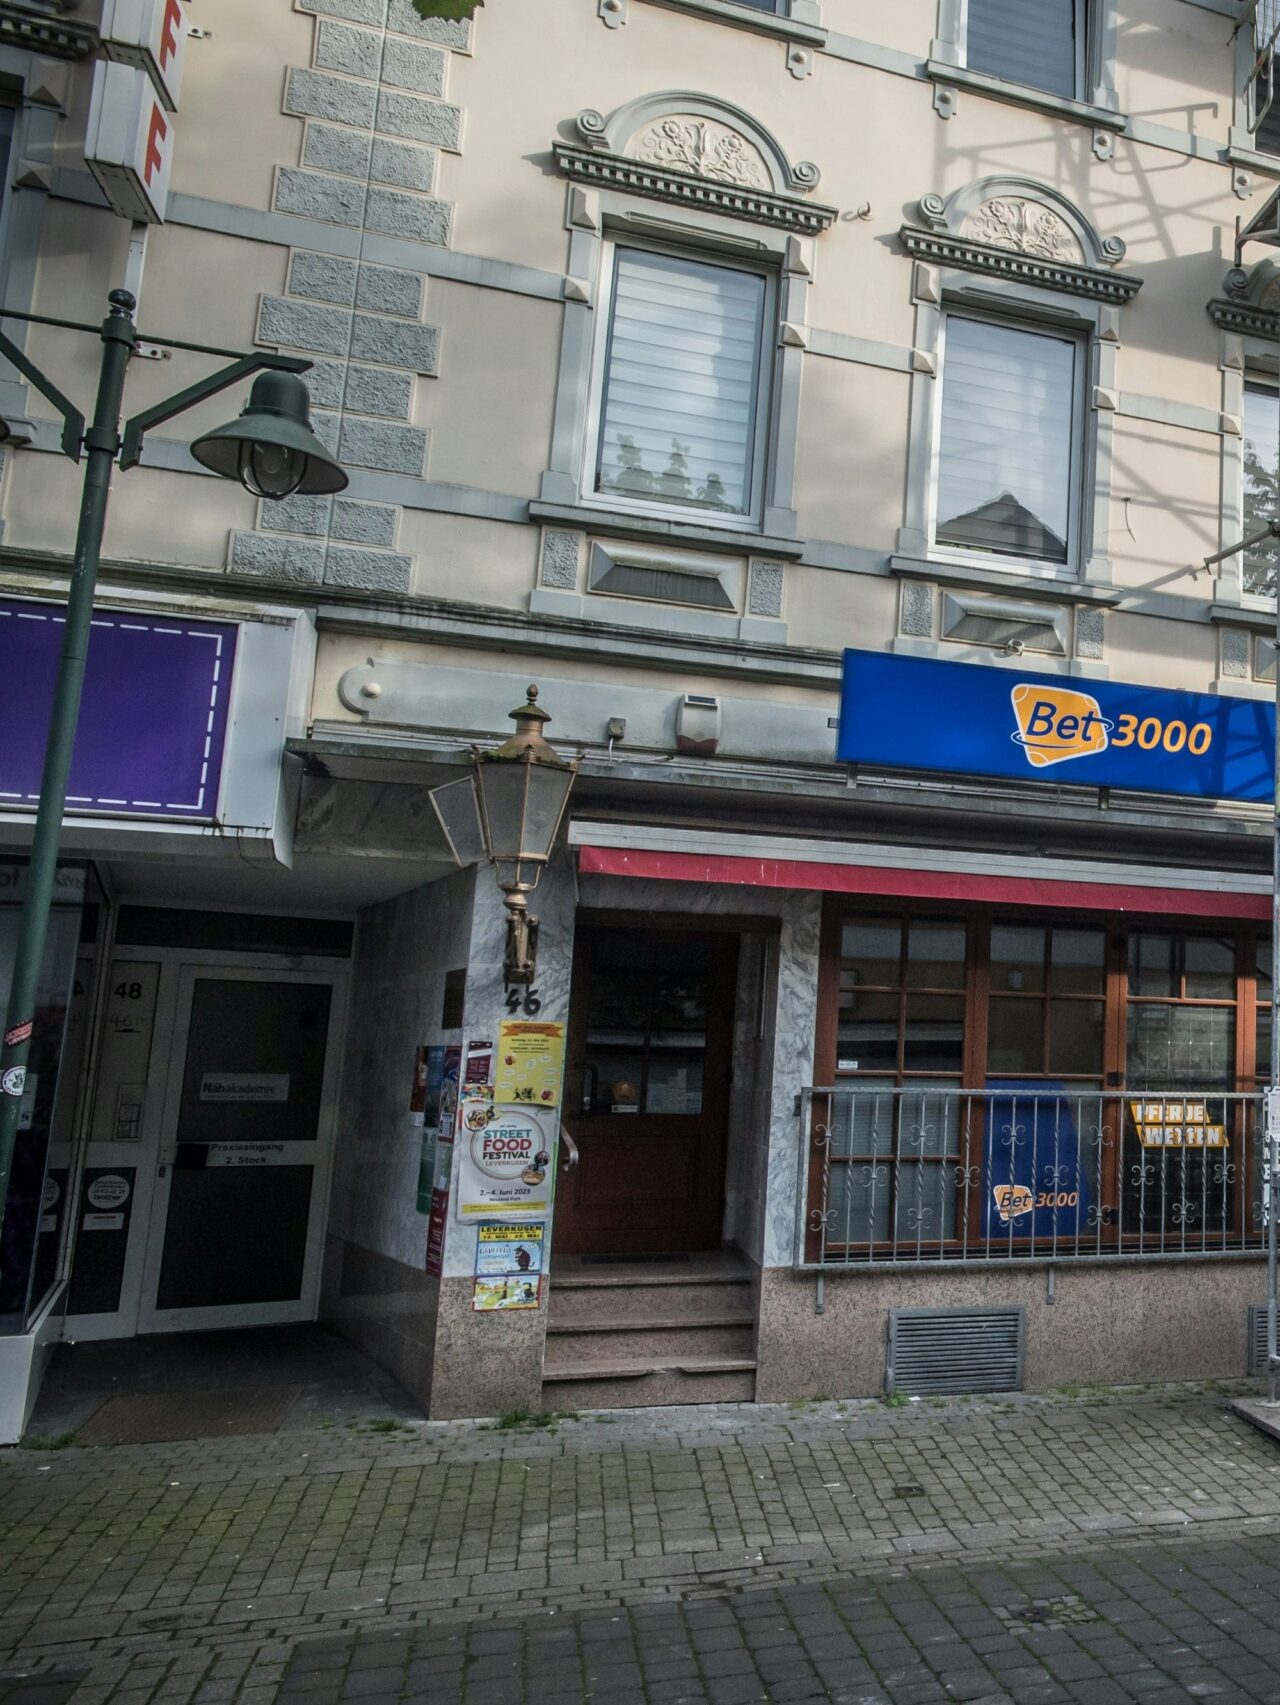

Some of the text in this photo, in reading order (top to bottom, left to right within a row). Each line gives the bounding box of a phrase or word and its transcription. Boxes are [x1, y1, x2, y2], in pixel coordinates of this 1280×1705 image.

[1026, 701, 1212, 755] Bet 3000
[114, 982, 142, 999] 48
[505, 989, 541, 1016] 46
[484, 1129, 532, 1139] STREET
[1145, 1127, 1221, 1145] WETTEN
[211, 1143, 284, 1152] Praxiseingang
[483, 1139, 532, 1151] FOOD
[483, 1151, 530, 1160] FESTIVAL
[514, 1188, 531, 1196] 2023
[1000, 1191, 1079, 1208] Bet 3000
[481, 1225, 541, 1233] LEVERKUSEN
